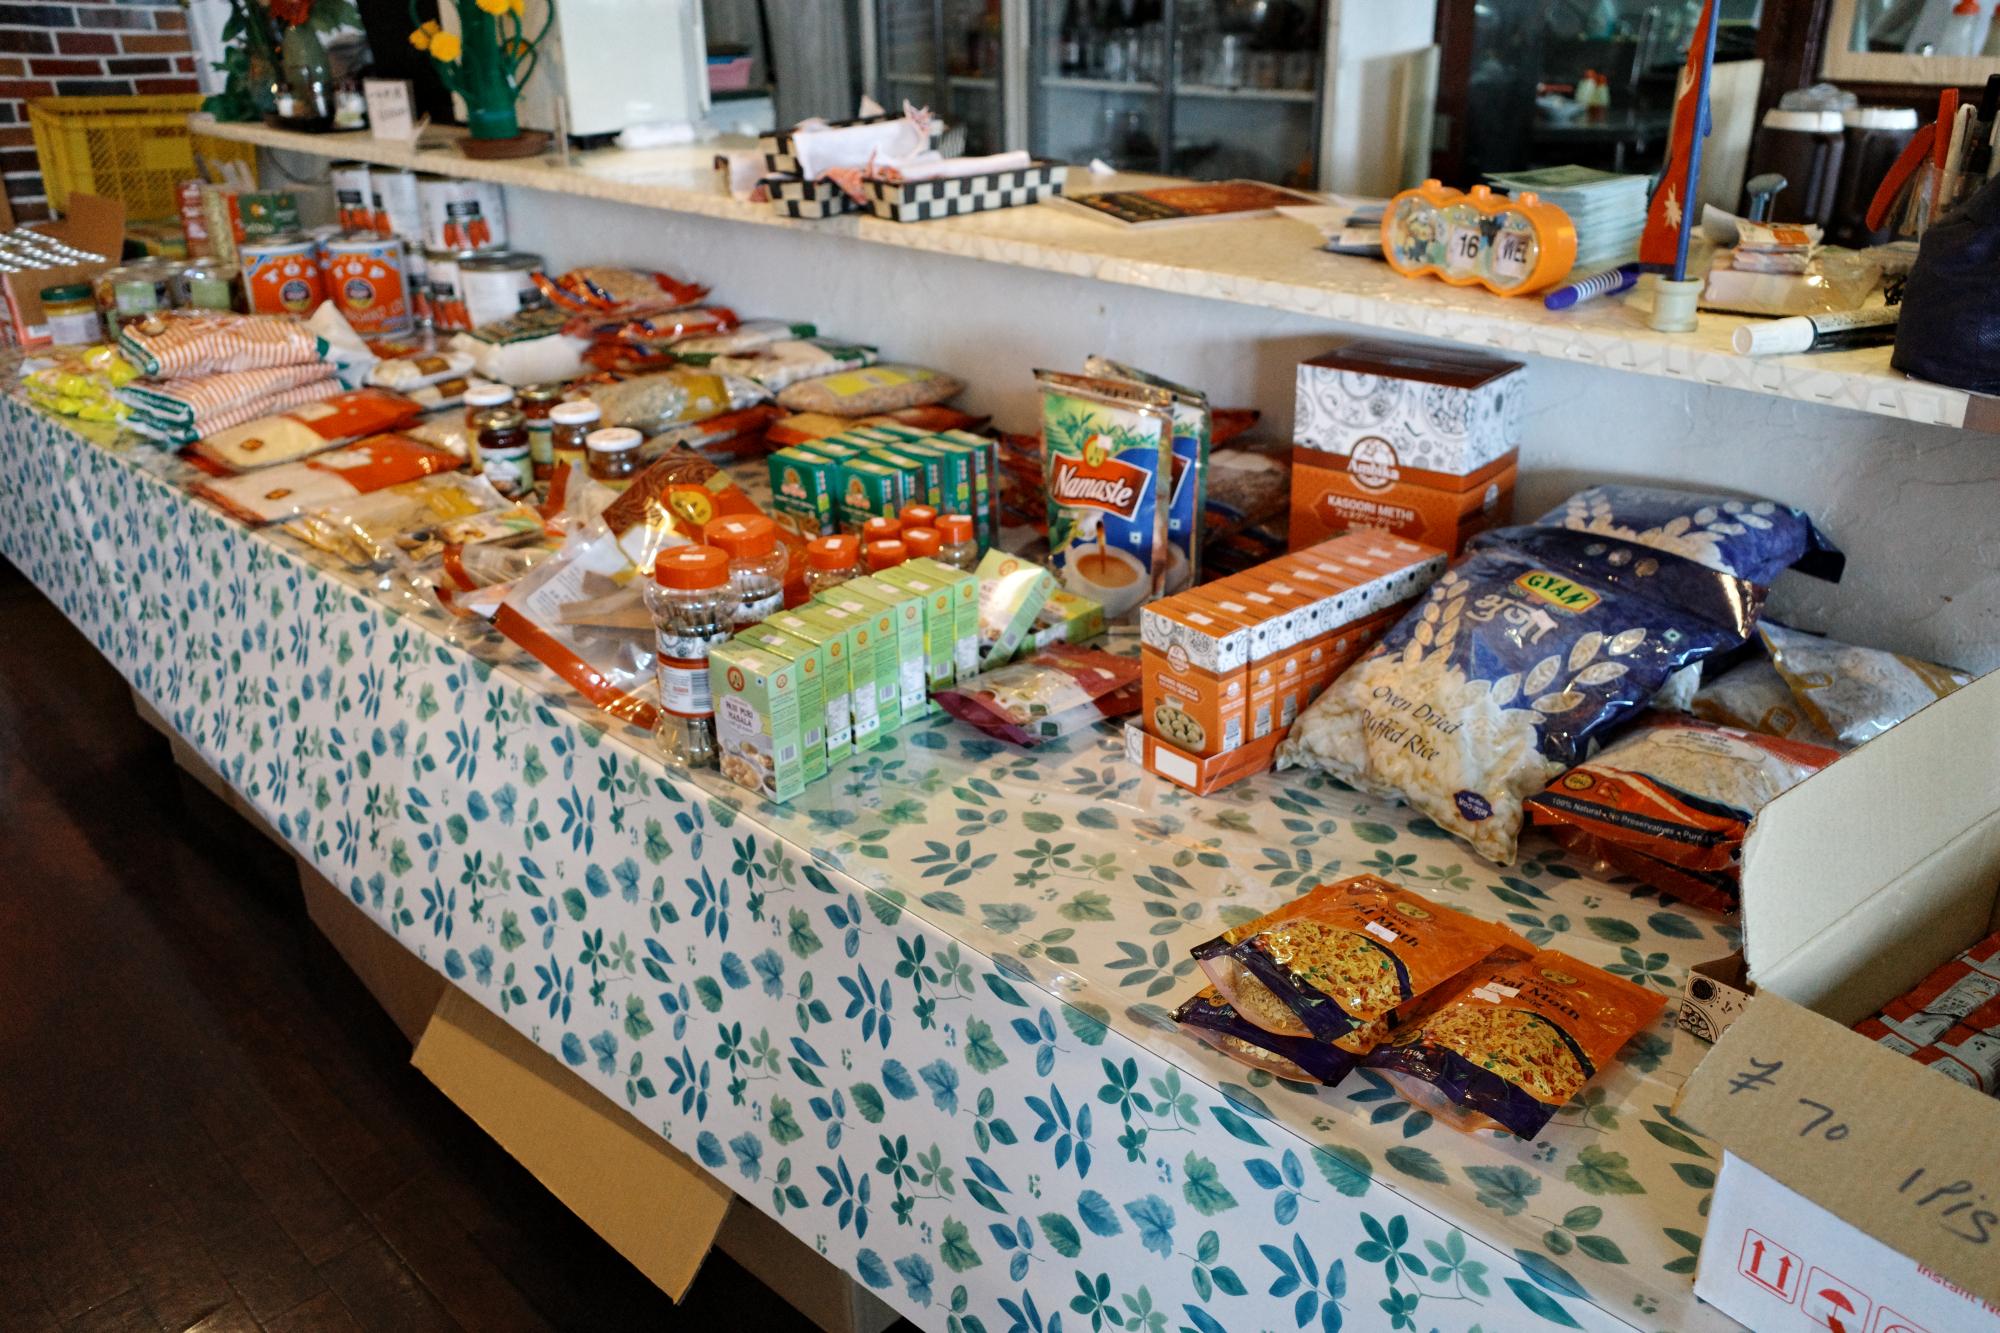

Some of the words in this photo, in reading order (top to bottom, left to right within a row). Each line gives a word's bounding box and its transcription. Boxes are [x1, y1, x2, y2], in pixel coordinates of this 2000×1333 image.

[1459, 233, 1480, 258] 16
[1054, 463, 1134, 507] Namaste
[1327, 494, 1377, 513] KASOORI
[1378, 504, 1415, 521] METHI
[1527, 574, 1589, 605] GYAN
[1373, 686, 1412, 711] Oven
[1412, 703, 1464, 735] Dried
[1361, 708, 1409, 744] Puffed
[1402, 734, 1440, 761] Rice
[1552, 797, 1572, 810] 100%
[1573, 803, 1603, 817] Natural
[1621, 815, 1675, 836] Preservatives
[1683, 830, 1702, 842] Pure
[1529, 988, 1580, 1021] Moth
[1798, 1098, 1849, 1140] 70
[1917, 1263, 1976, 1303] Instant
